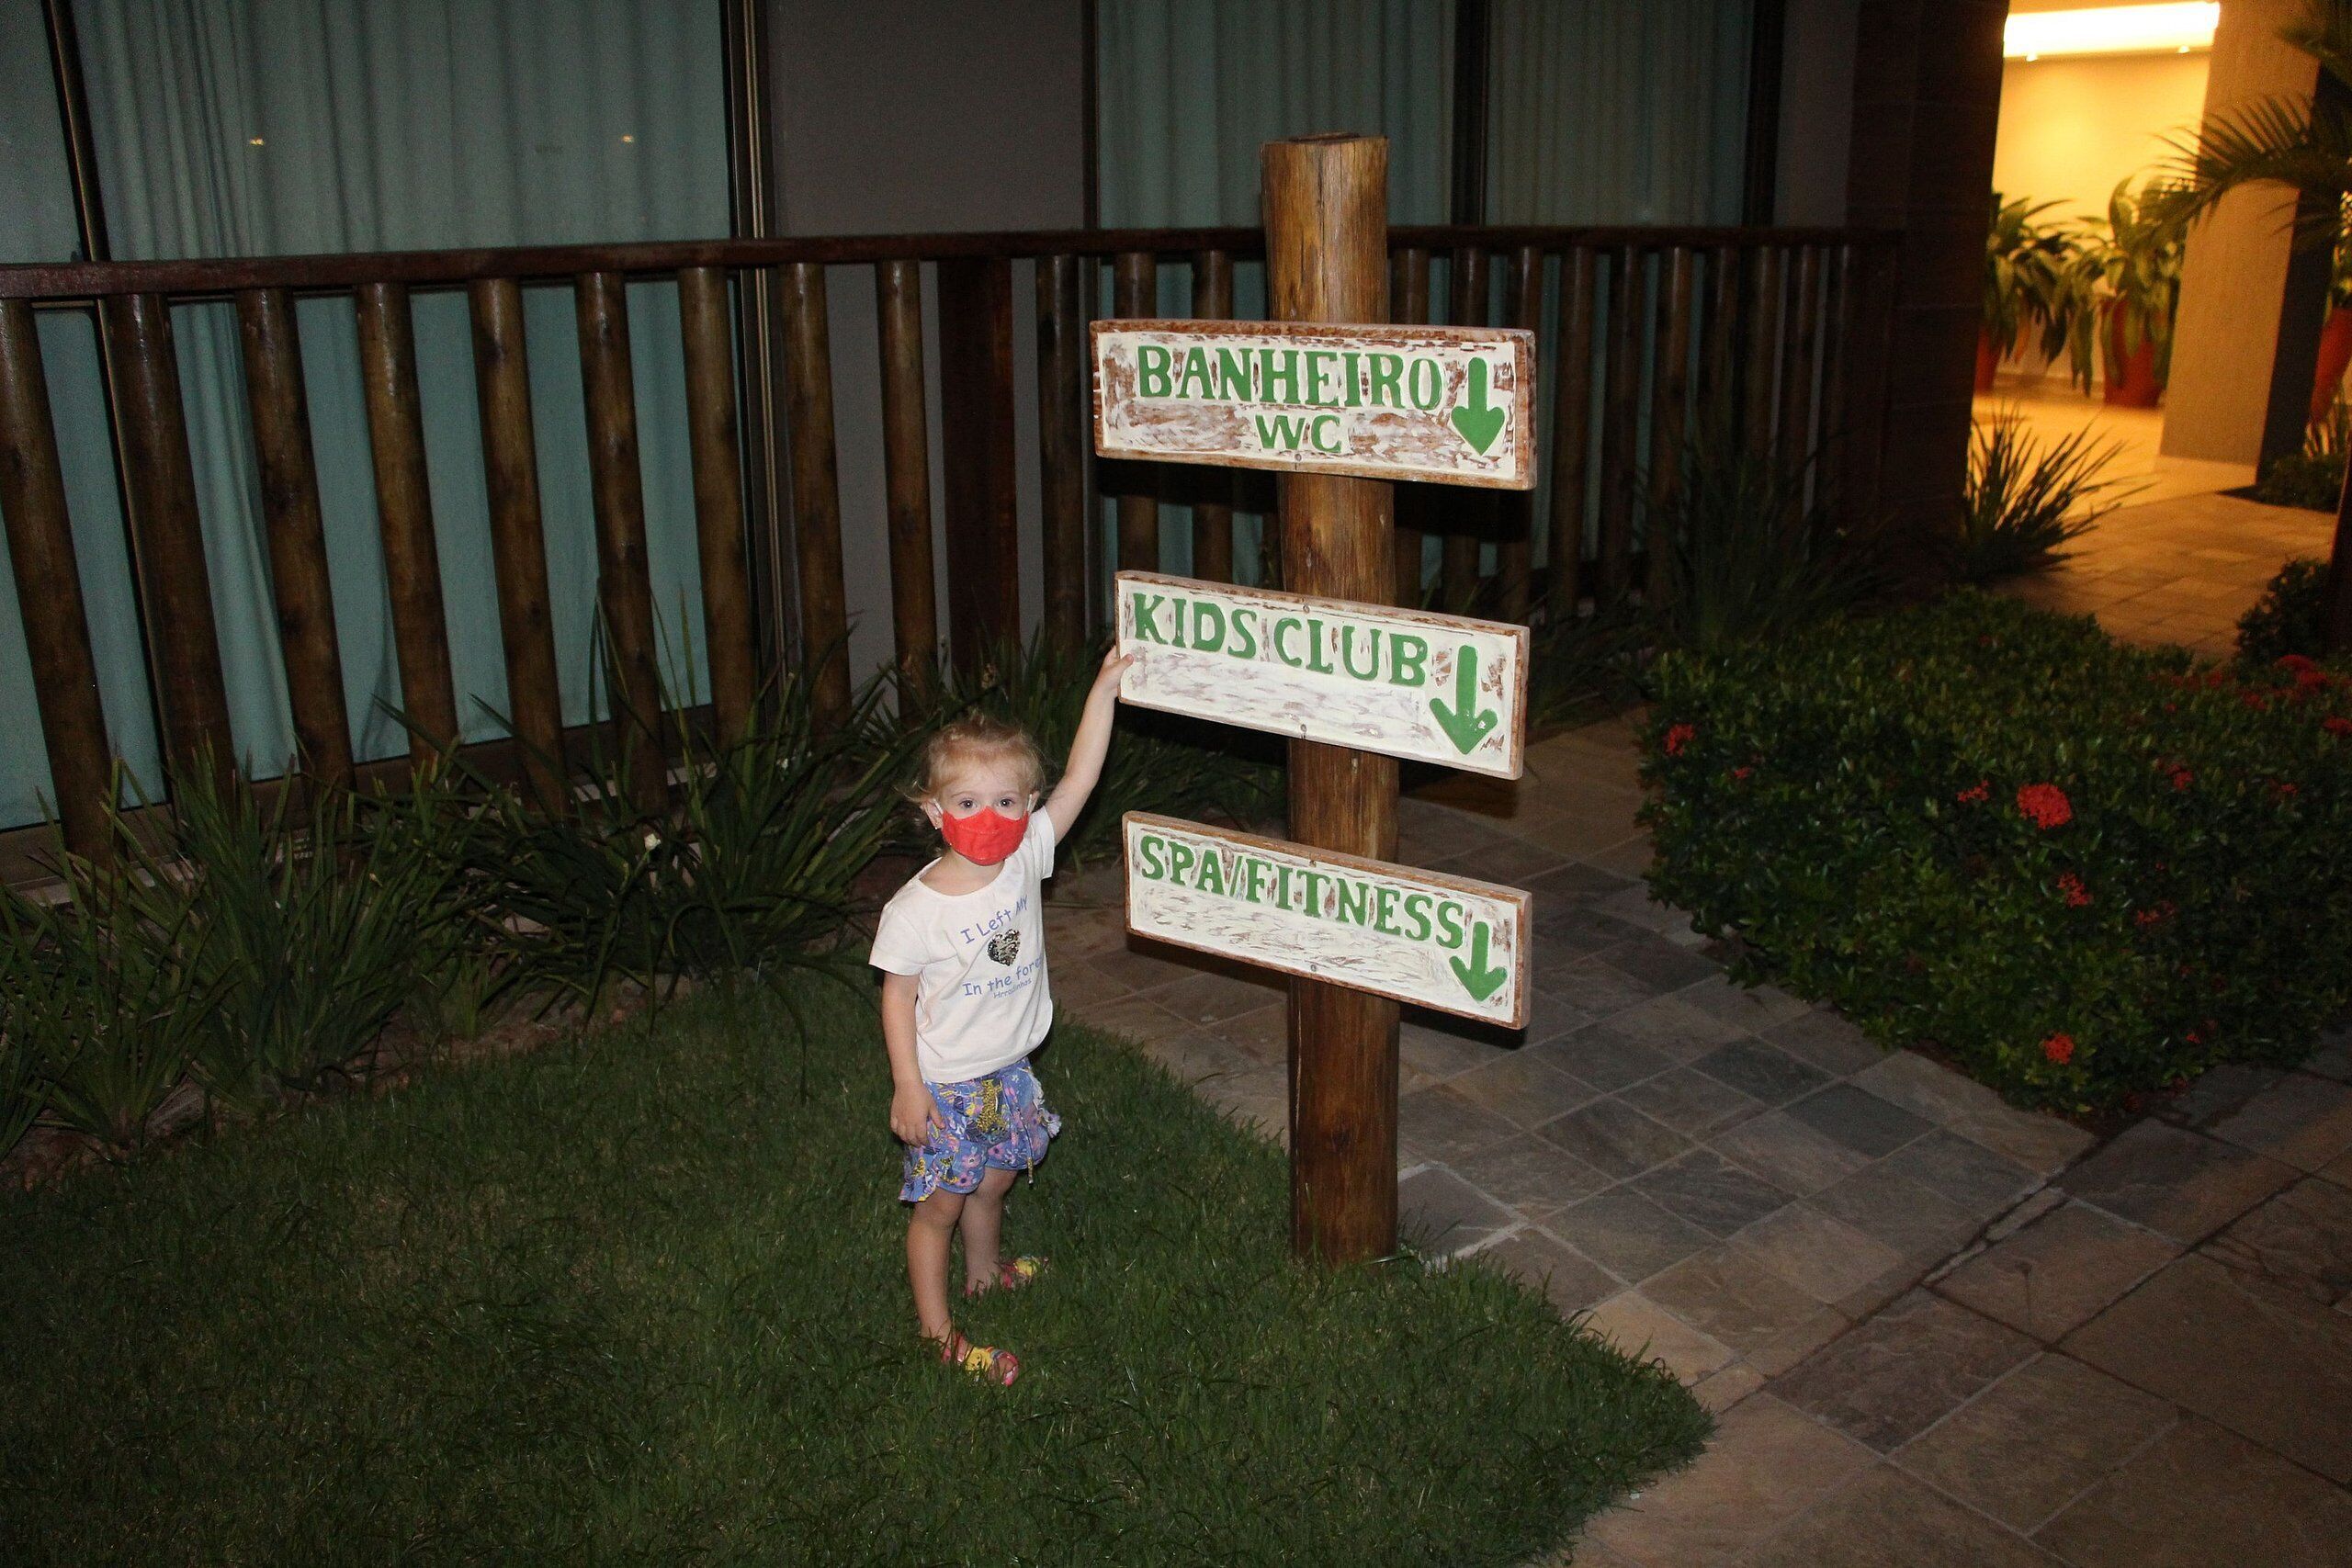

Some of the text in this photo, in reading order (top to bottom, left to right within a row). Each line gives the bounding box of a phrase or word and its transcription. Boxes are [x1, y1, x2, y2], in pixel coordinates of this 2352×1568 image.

[1136, 344, 1442, 411] BANHEIRO
[1255, 413, 1342, 453] WC
[1132, 592, 1429, 687] KIDS CLUB
[1139, 834, 1464, 950] SPA/FITNESS
[960, 928, 975, 944] I
[976, 908, 1012, 937] Left
[962, 982, 982, 997] In
[987, 975, 1012, 992] the
